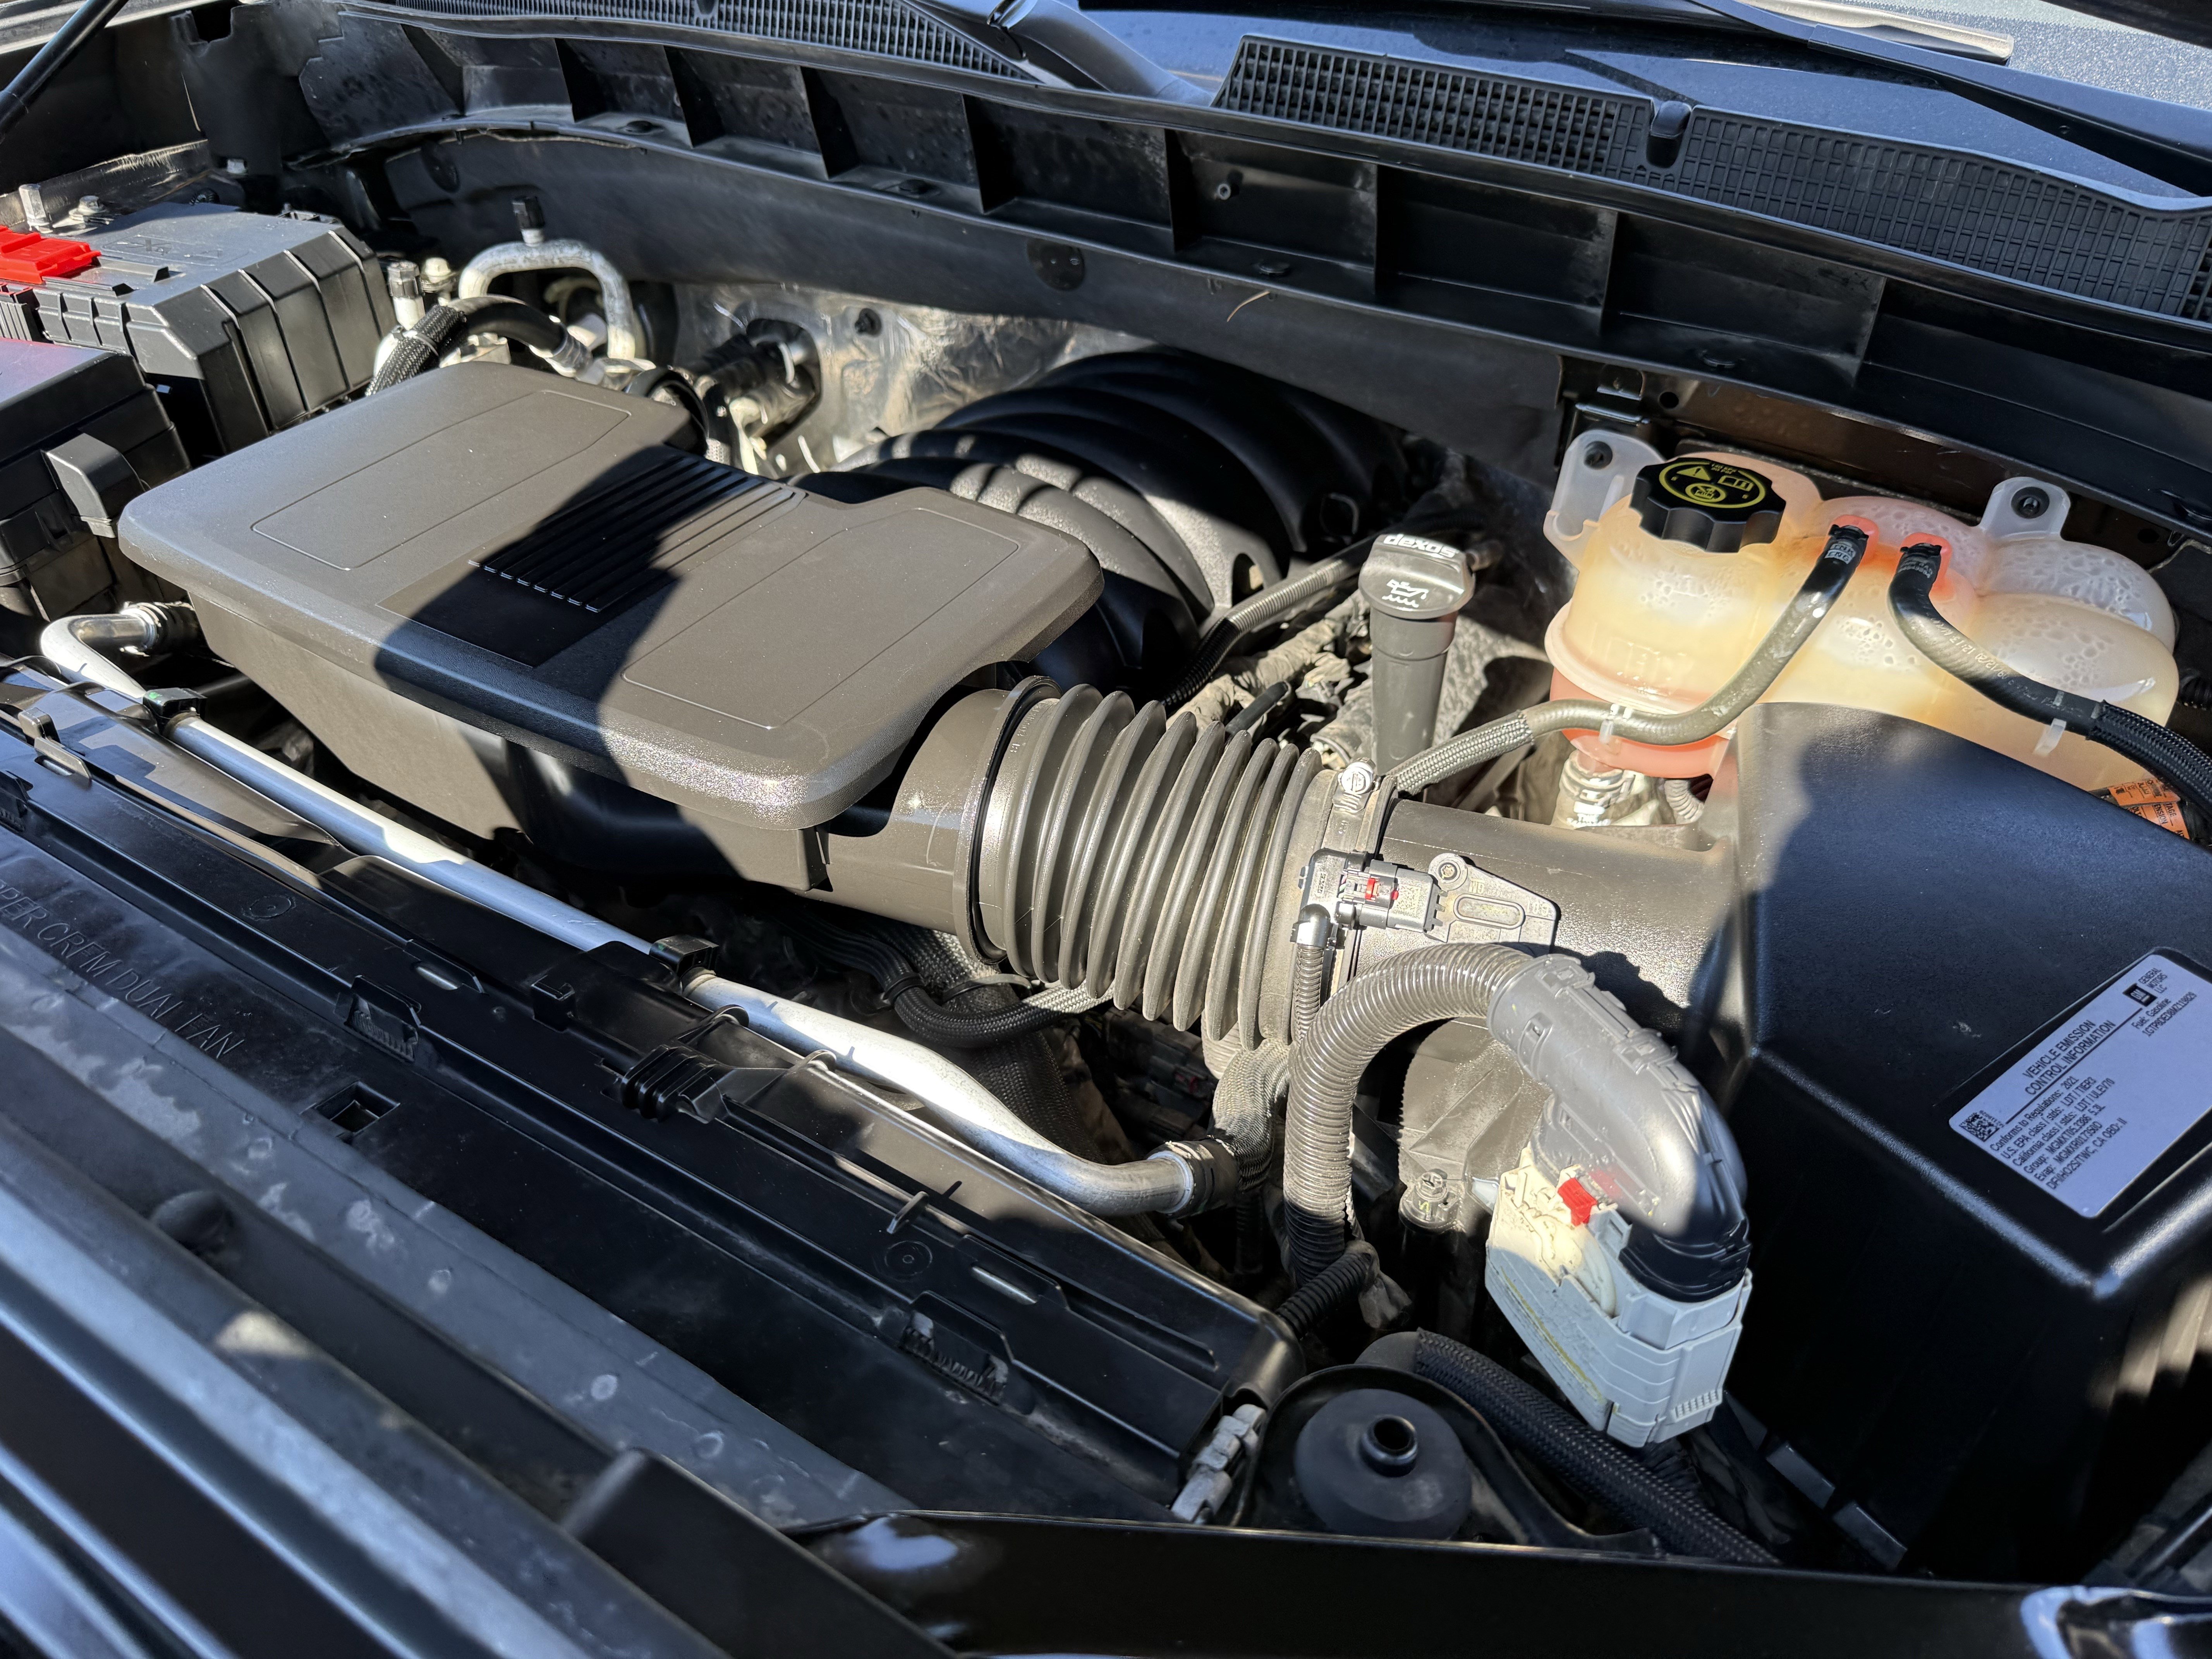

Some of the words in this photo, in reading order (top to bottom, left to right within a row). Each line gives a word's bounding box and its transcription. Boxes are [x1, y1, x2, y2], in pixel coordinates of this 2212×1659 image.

[1384, 534, 1458, 558] dexos
[38, 923, 121, 978] CRFM
[175, 1013, 245, 1058] FAN
[2138, 966, 2162, 984] GENERAL
[2146, 972, 2168, 989] MOTORS
[2154, 983, 2168, 994] LLC
[2129, 988, 2146, 1000] GM
[2130, 1015, 2150, 1030] Fuel:
[2145, 996, 2172, 1018] Gasoline
[2022, 1048, 2061, 1080] VEHICLE
[2055, 1019, 2095, 1052] EMISSION
[2024, 1060, 2068, 1096] CONTROL
[2061, 1019, 2116, 1065] INFORMATION
[1989, 1123, 2023, 1152] Conforms
[2017, 1118, 2030, 1127] to
[2024, 1088, 2063, 1121] Regulations:
[2060, 1075, 2079, 1090] 2021
[2000, 1144, 2019, 1159] U.S.
[2013, 1133, 2031, 1148] EPA
[2025, 1120, 2045, 1137] class
[2044, 1104, 2064, 1121] stds:
[2060, 1092, 2078, 1106] LDT
[2075, 1076, 2097, 1094] TIER3
[2011, 1138, 2045, 1167] California
[2038, 1125, 2059, 1142] class
[2057, 1110, 2076, 1126] stds:
[2073, 1097, 2092, 1112] LDT
[2088, 1077, 2115, 1099] ULEV70
[2022, 1152, 2049, 1175] Group:
[2088, 1101, 2106, 1116] 5.3L
[2091, 1135, 2107, 1148] CA
[2101, 1121, 2123, 1139] OBD:
[2033, 1163, 2057, 1182] Evap:
